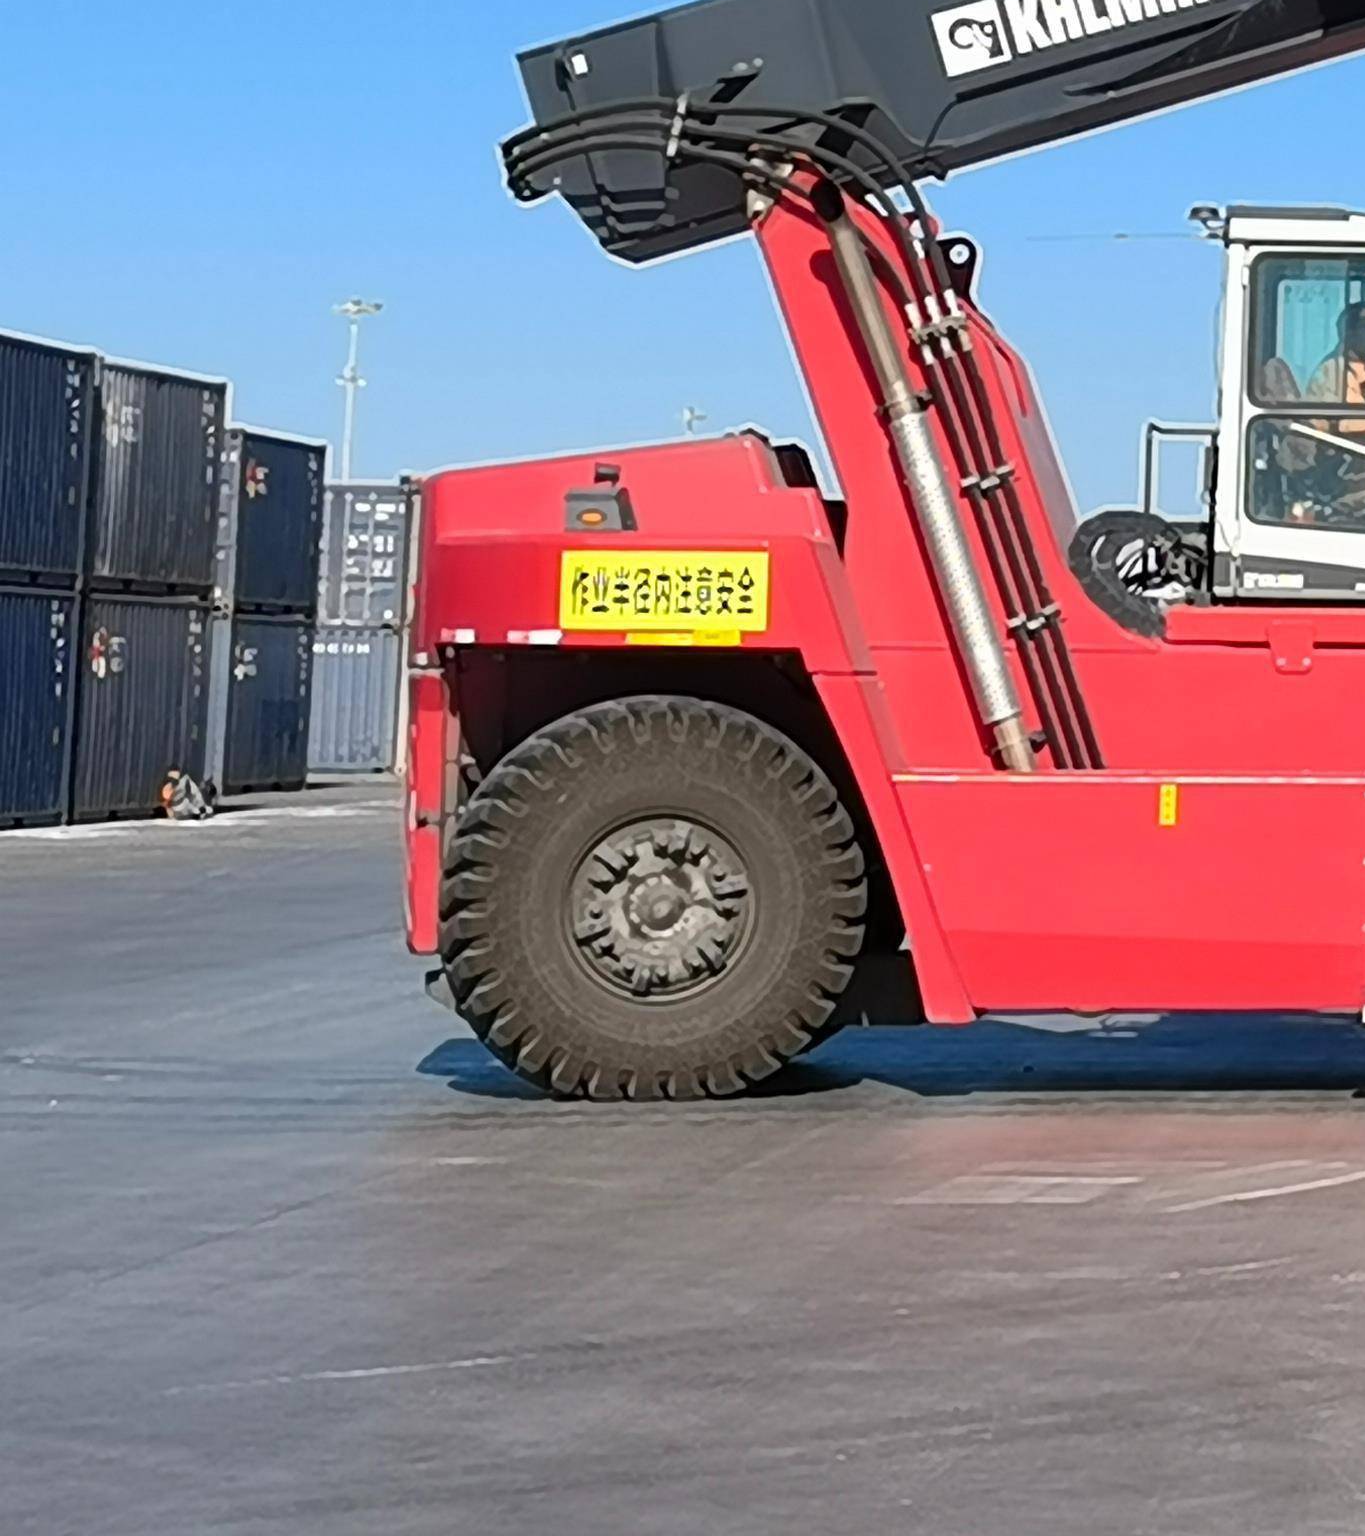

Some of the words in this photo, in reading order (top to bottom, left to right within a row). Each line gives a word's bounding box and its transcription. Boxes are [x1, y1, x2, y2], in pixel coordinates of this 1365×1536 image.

[571, 566, 756, 616] 作业半径内注意安全
